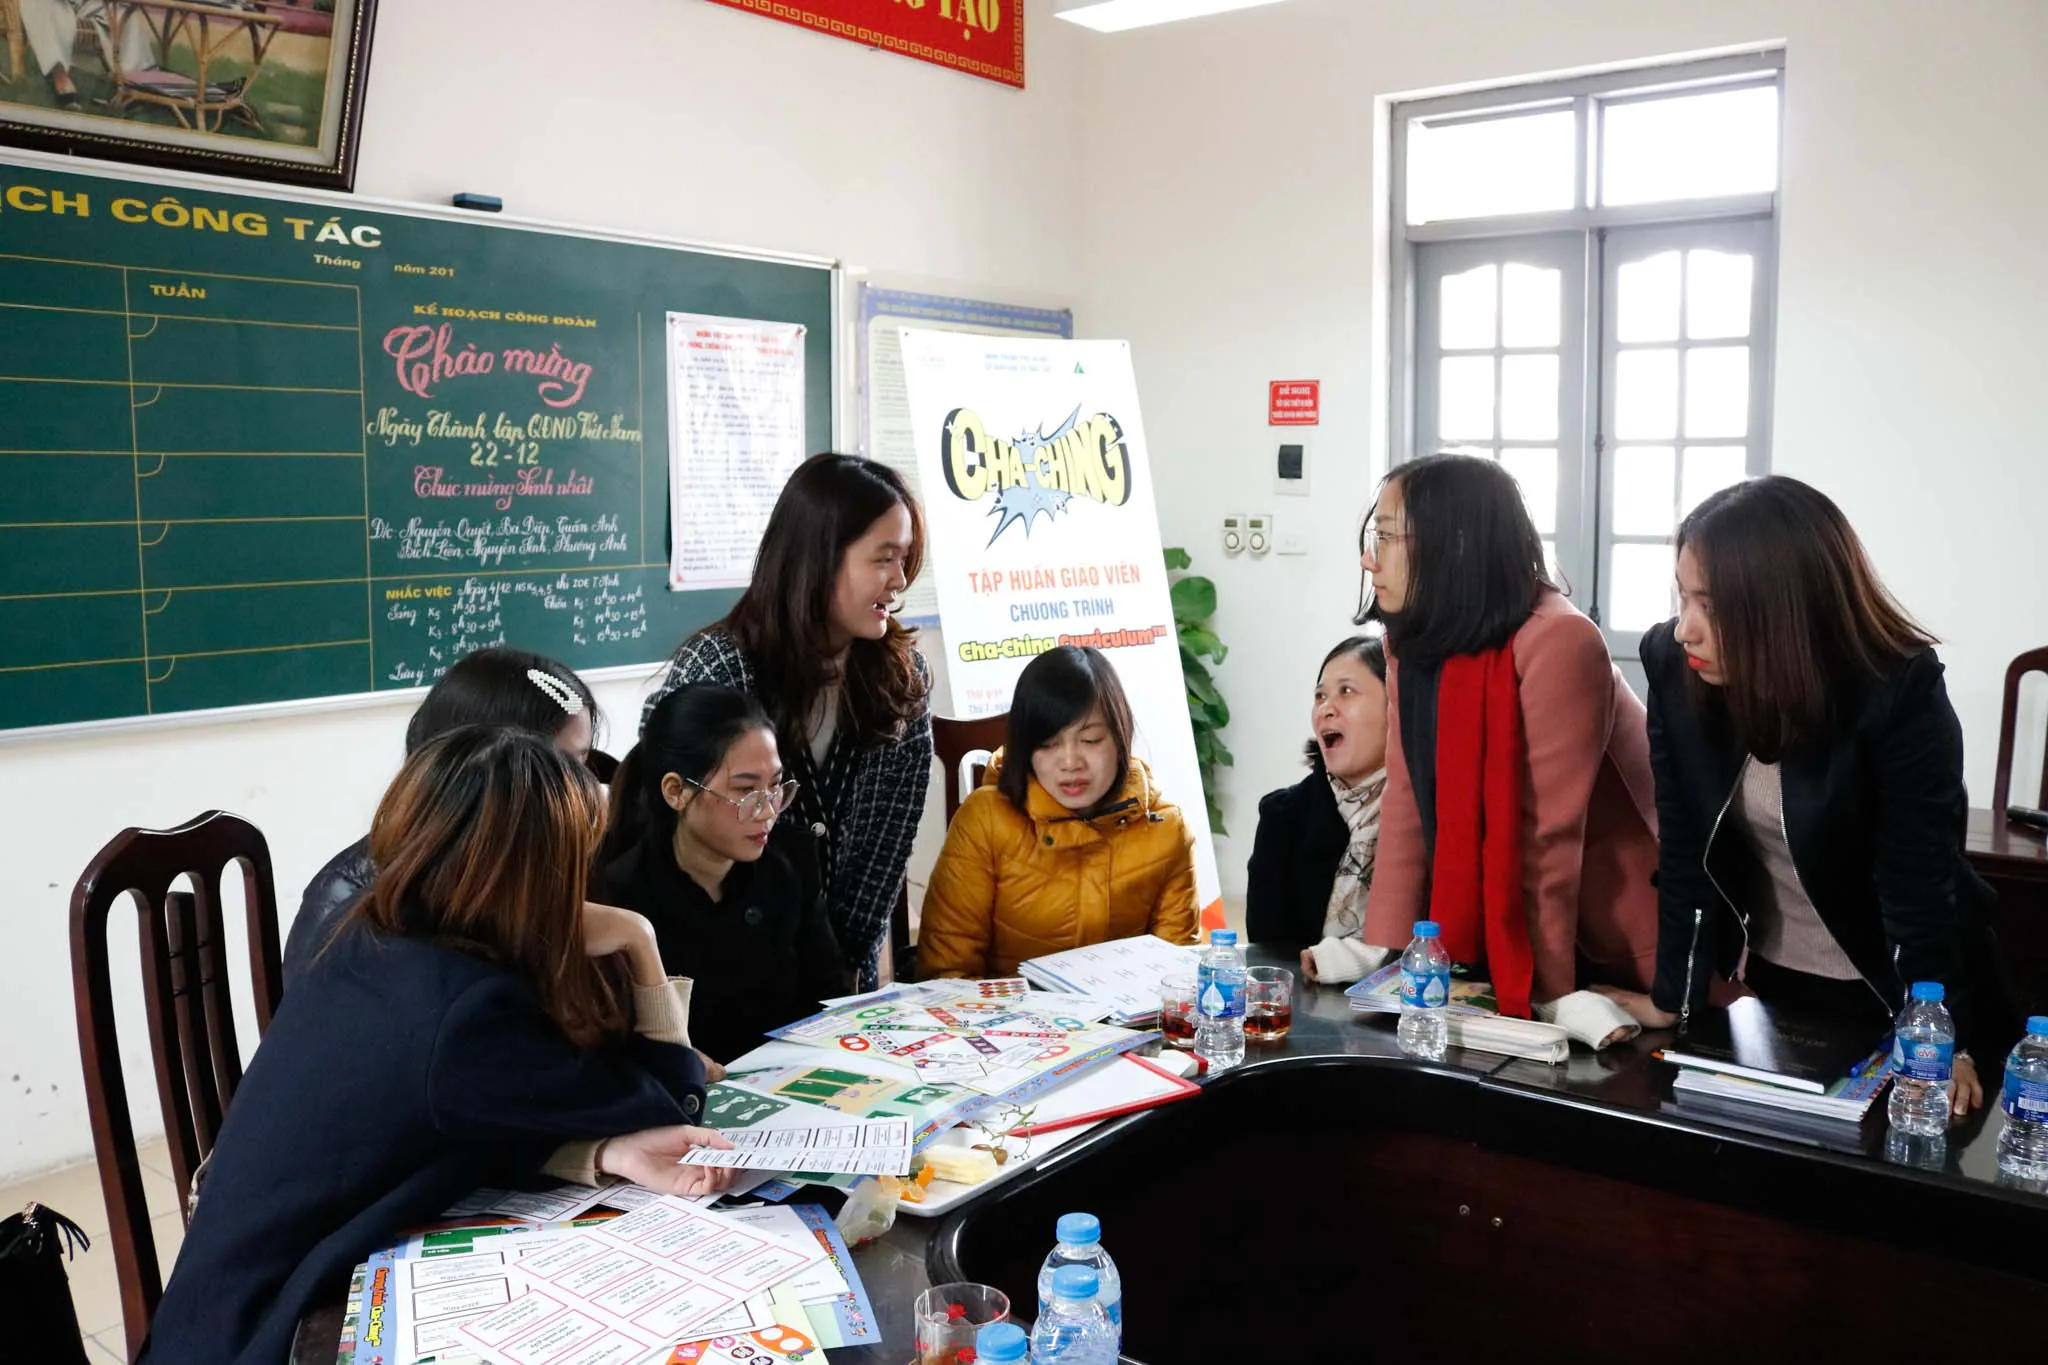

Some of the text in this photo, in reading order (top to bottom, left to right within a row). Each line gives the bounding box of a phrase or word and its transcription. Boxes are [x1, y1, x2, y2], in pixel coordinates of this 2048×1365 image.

[0, 185, 382, 248] CH CÔNG TÁC
[313, 254, 454, 277] Tháng năm 201
[441, 307, 501, 321] HOẠCH
[504, 311, 549, 324] CÔNG
[552, 315, 597, 328] ĐOÀN
[383, 322, 593, 409] Chào mừng
[366, 407, 422, 447] Ngày
[426, 410, 486, 440] Thành
[941, 407, 1132, 507] CHA-CHING
